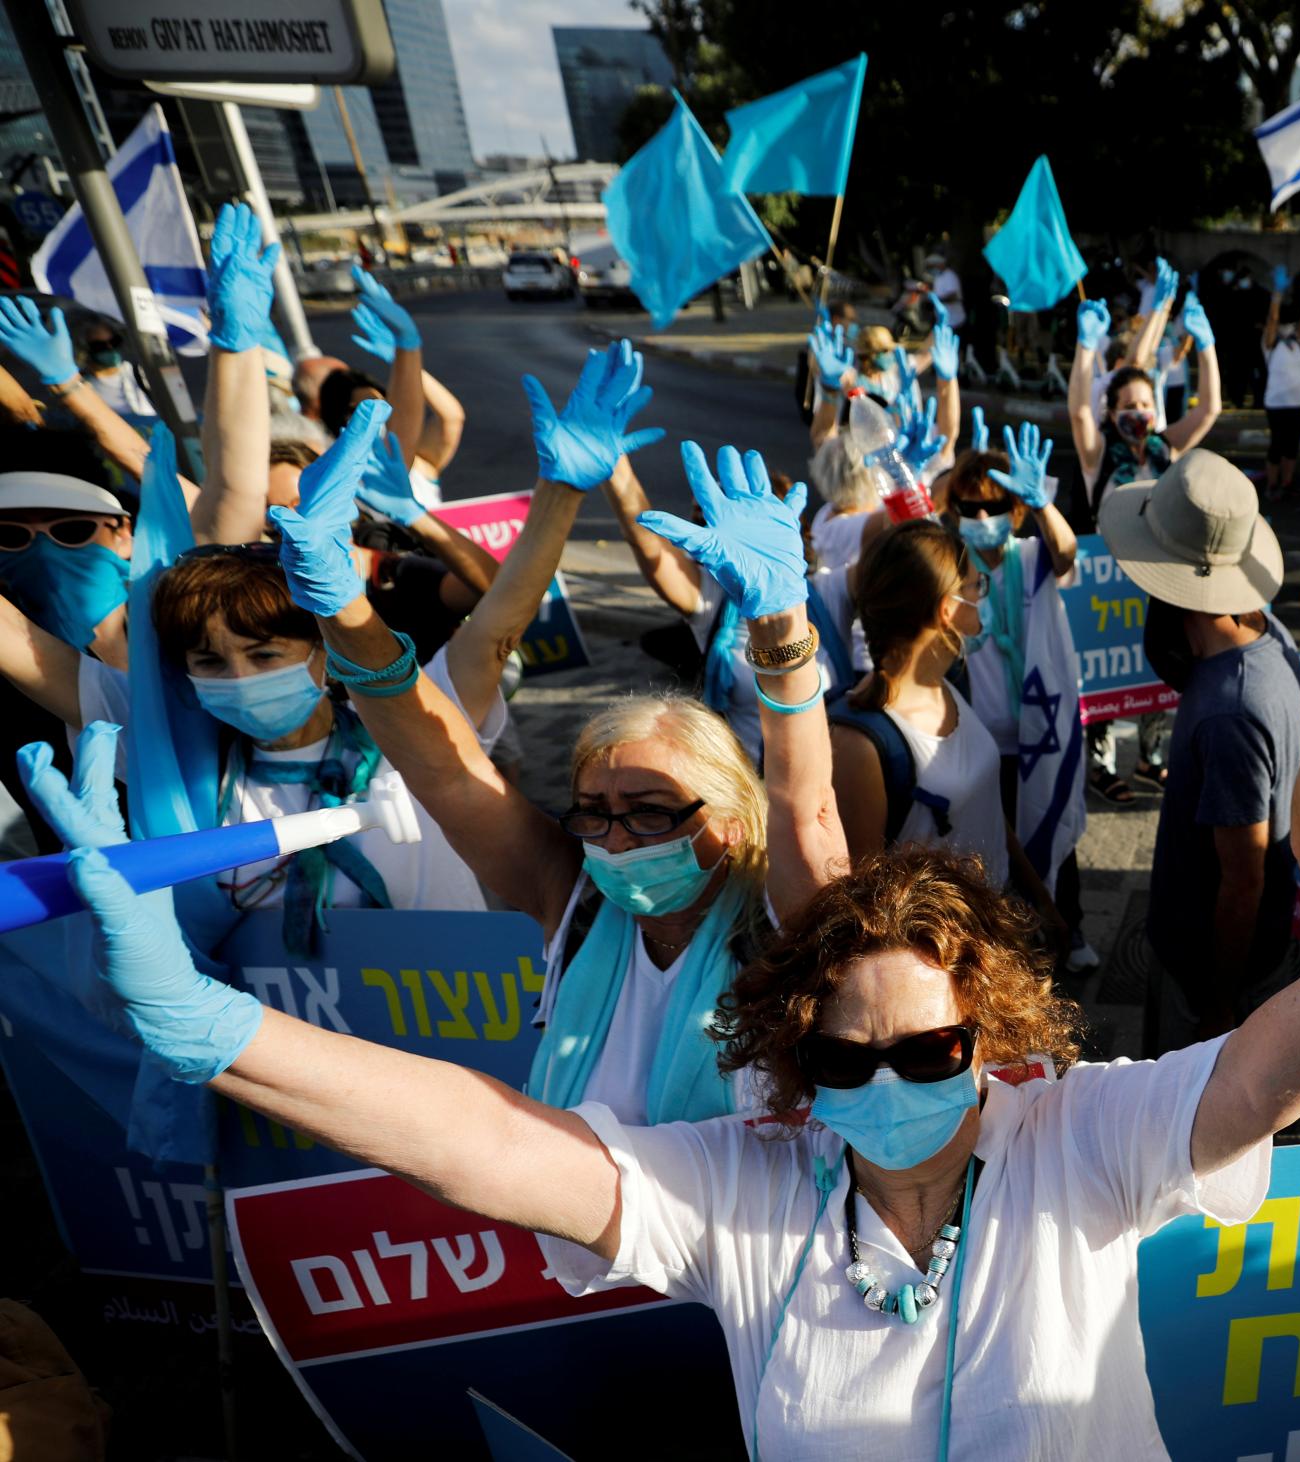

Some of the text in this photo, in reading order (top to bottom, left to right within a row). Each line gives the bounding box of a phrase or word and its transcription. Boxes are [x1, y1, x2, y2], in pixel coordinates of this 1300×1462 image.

[151, 18, 206, 51] GIV'AT
[209, 18, 332, 53] HATAHMOSHET
[1091, 595, 1149, 633] חיל
[1076, 644, 1143, 682] ומת
[290, 1230, 505, 1315] שלום
[103, 1295, 182, 1326] السلام
